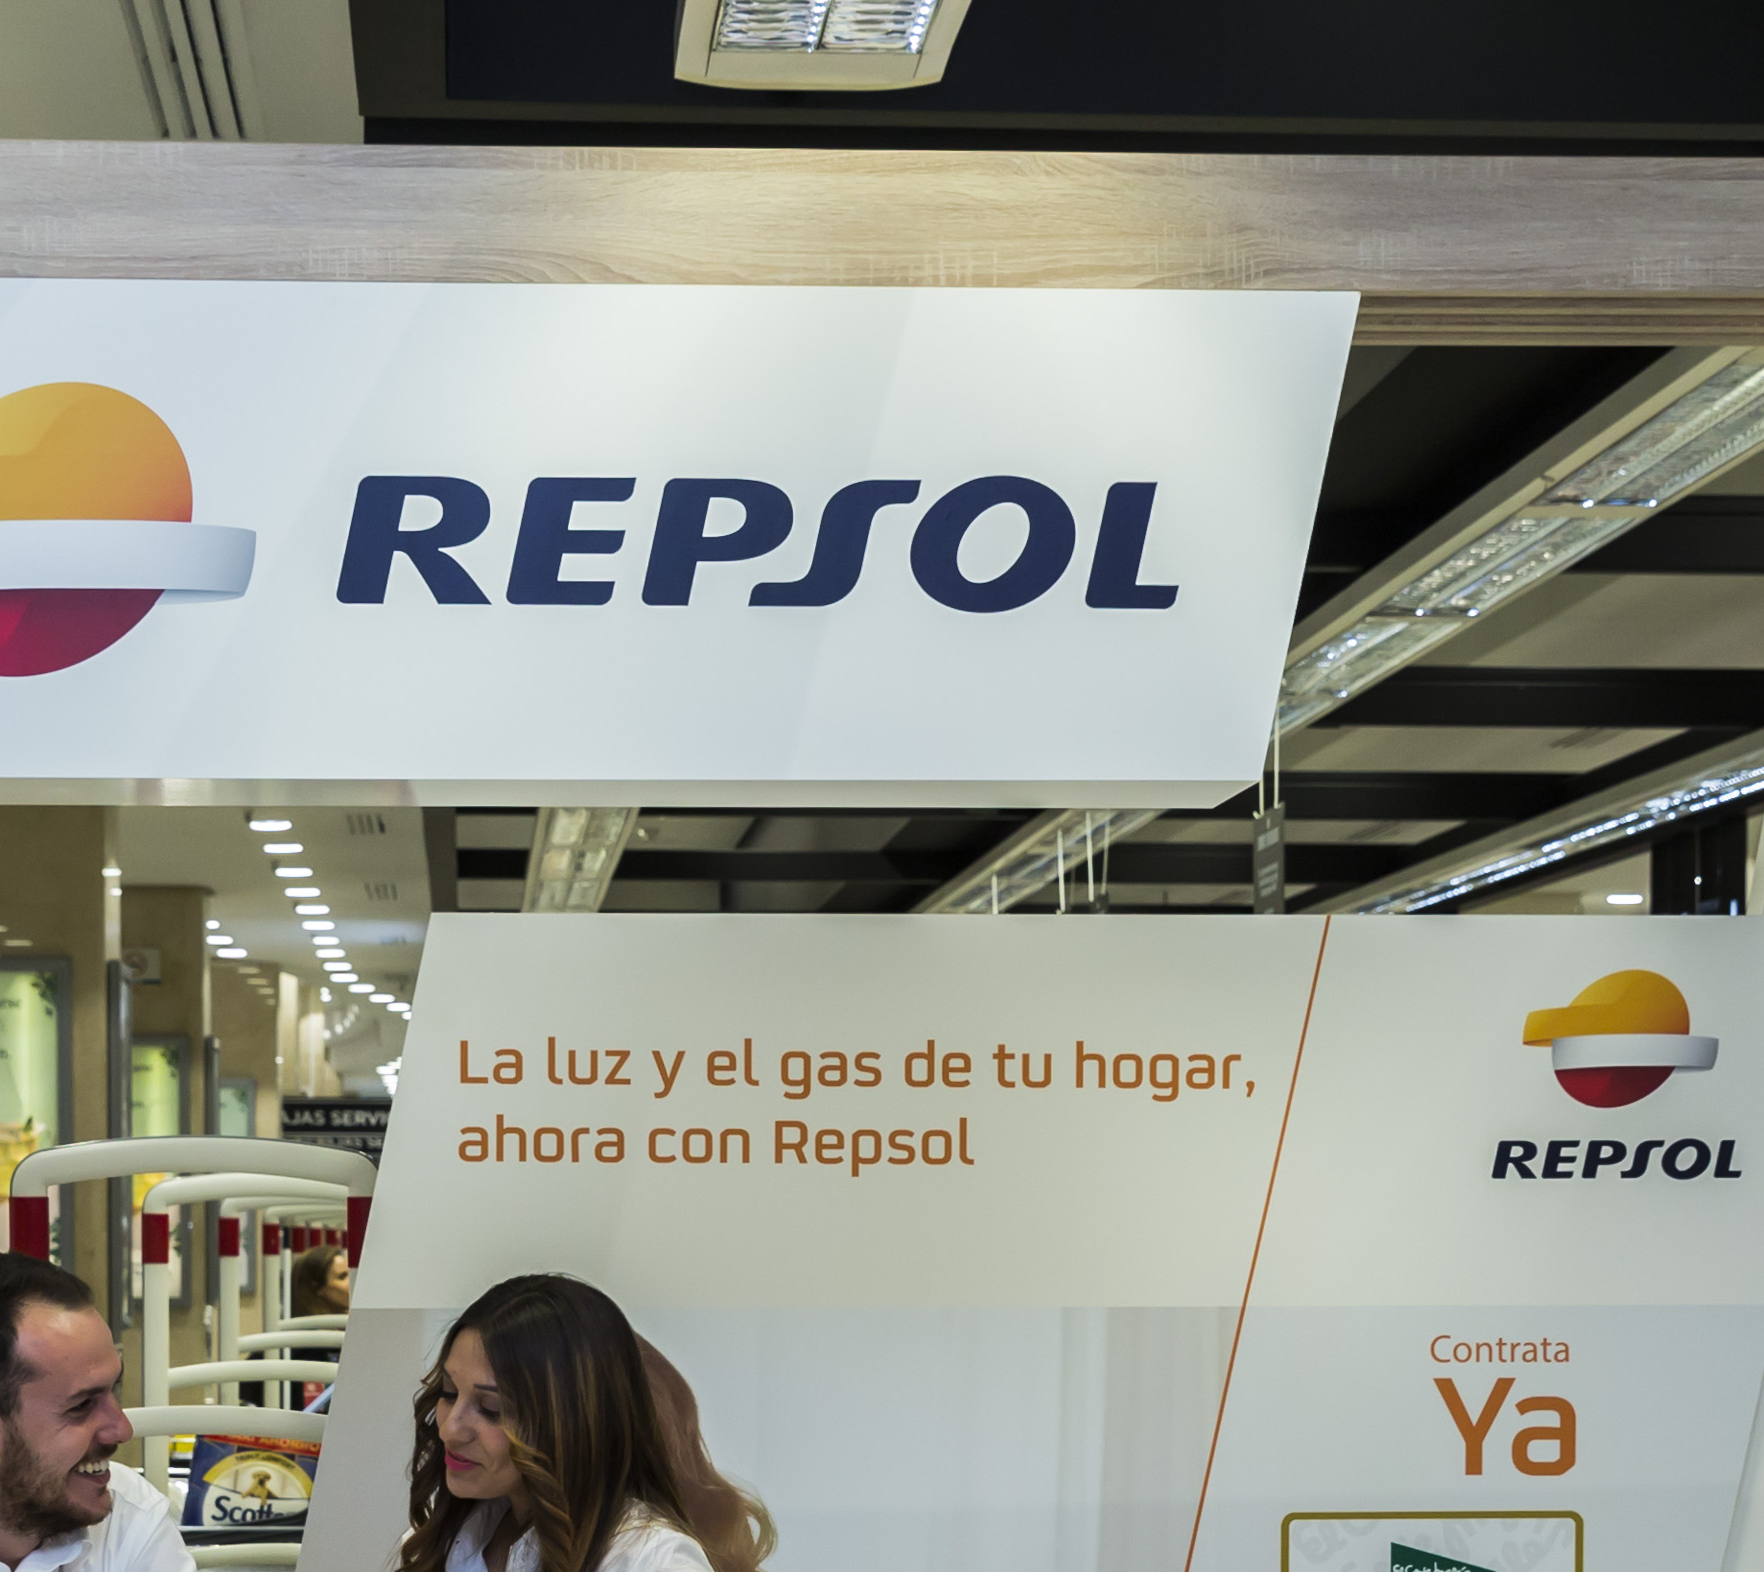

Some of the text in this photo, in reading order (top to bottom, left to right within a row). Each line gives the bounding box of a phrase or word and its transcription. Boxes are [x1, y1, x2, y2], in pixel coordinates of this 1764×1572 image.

[335, 474, 1180, 614] REPSOL
[458, 1036, 1256, 1103] La luz y el gas de tu hogar,
[457, 1114, 975, 1178] ahora con Repsol
[1491, 1138, 1743, 1181] REPSOL
[1429, 1334, 1571, 1364] Contrata
[1432, 1377, 1577, 1477] Ya
[211, 1495, 287, 1523] Scott
